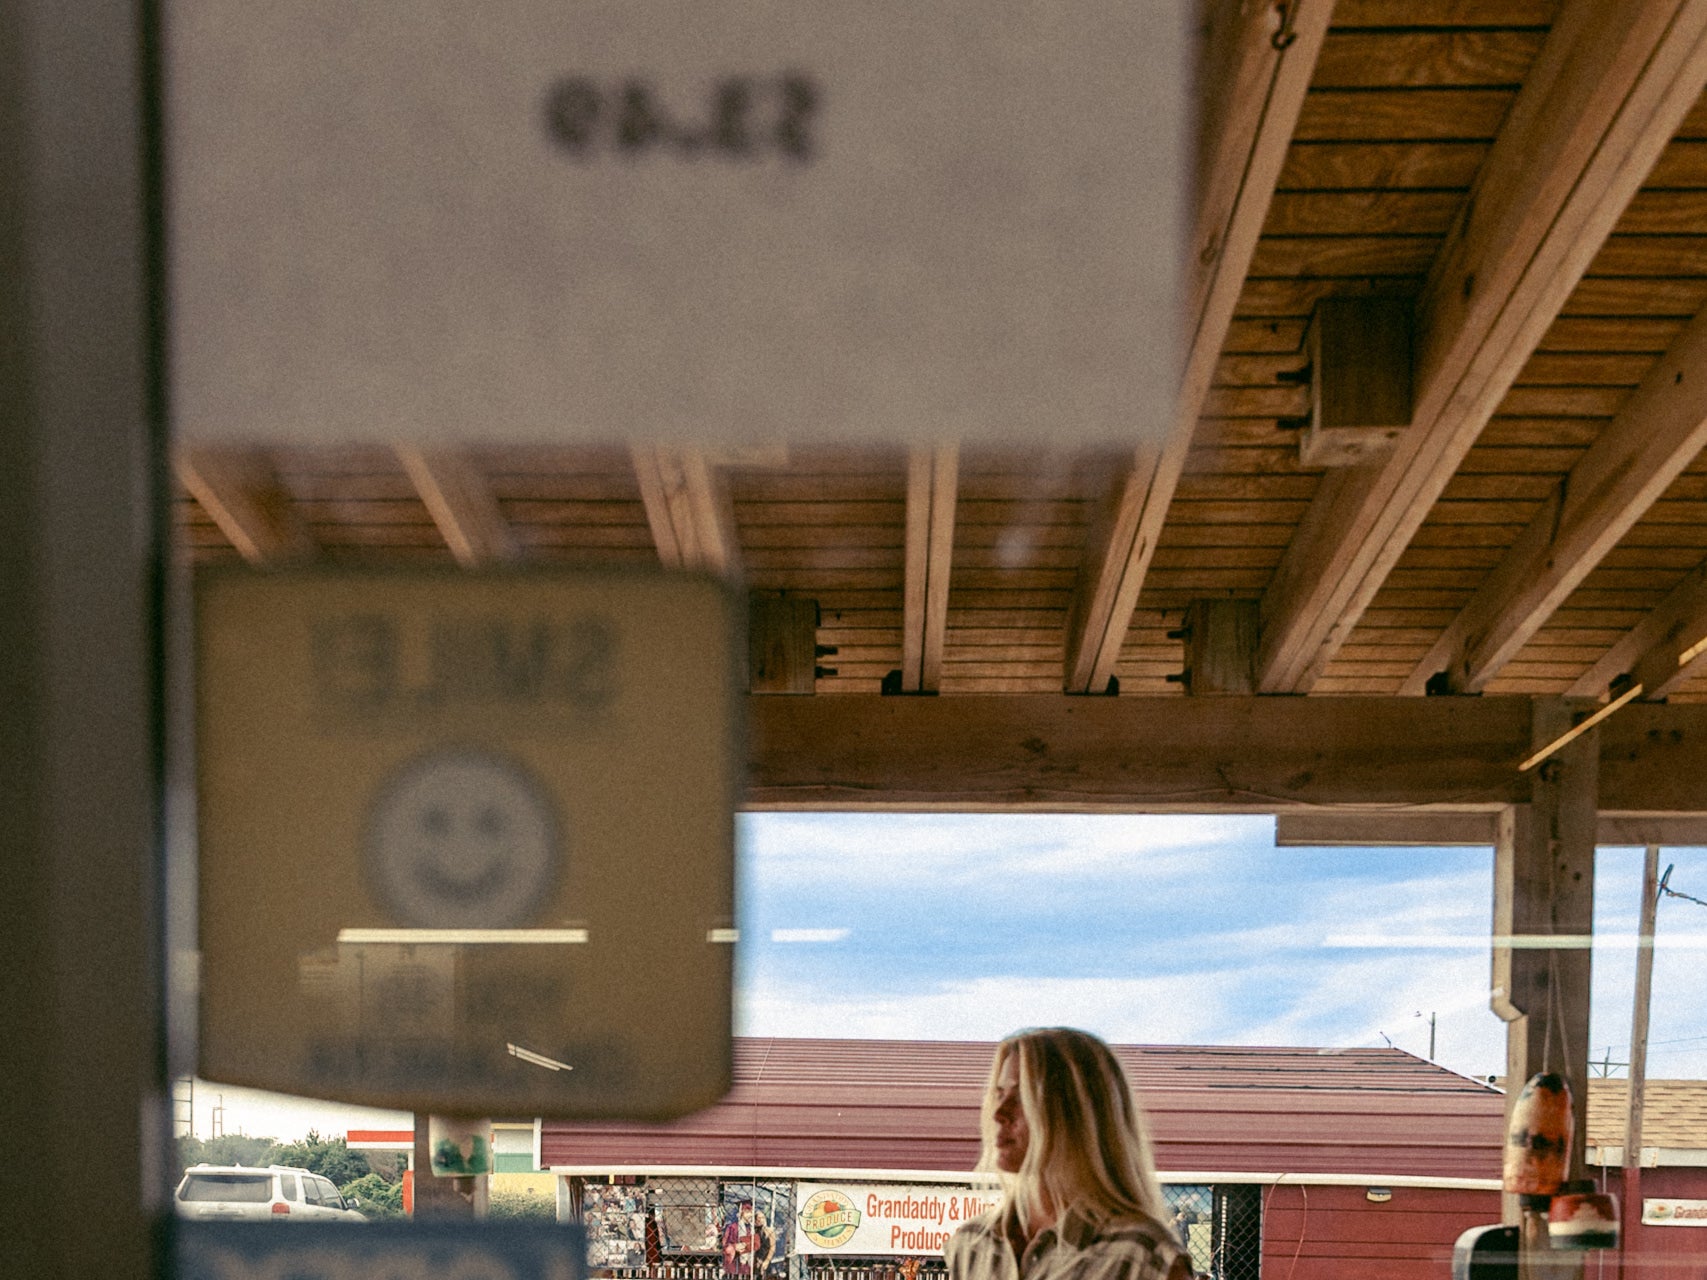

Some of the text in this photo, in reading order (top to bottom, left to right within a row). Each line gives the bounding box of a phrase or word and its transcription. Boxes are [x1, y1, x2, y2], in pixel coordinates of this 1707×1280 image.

[806, 1211, 853, 1230] PRODUCE
[866, 1192, 946, 1226] Grandaddy
[949, 1196, 960, 1221] &
